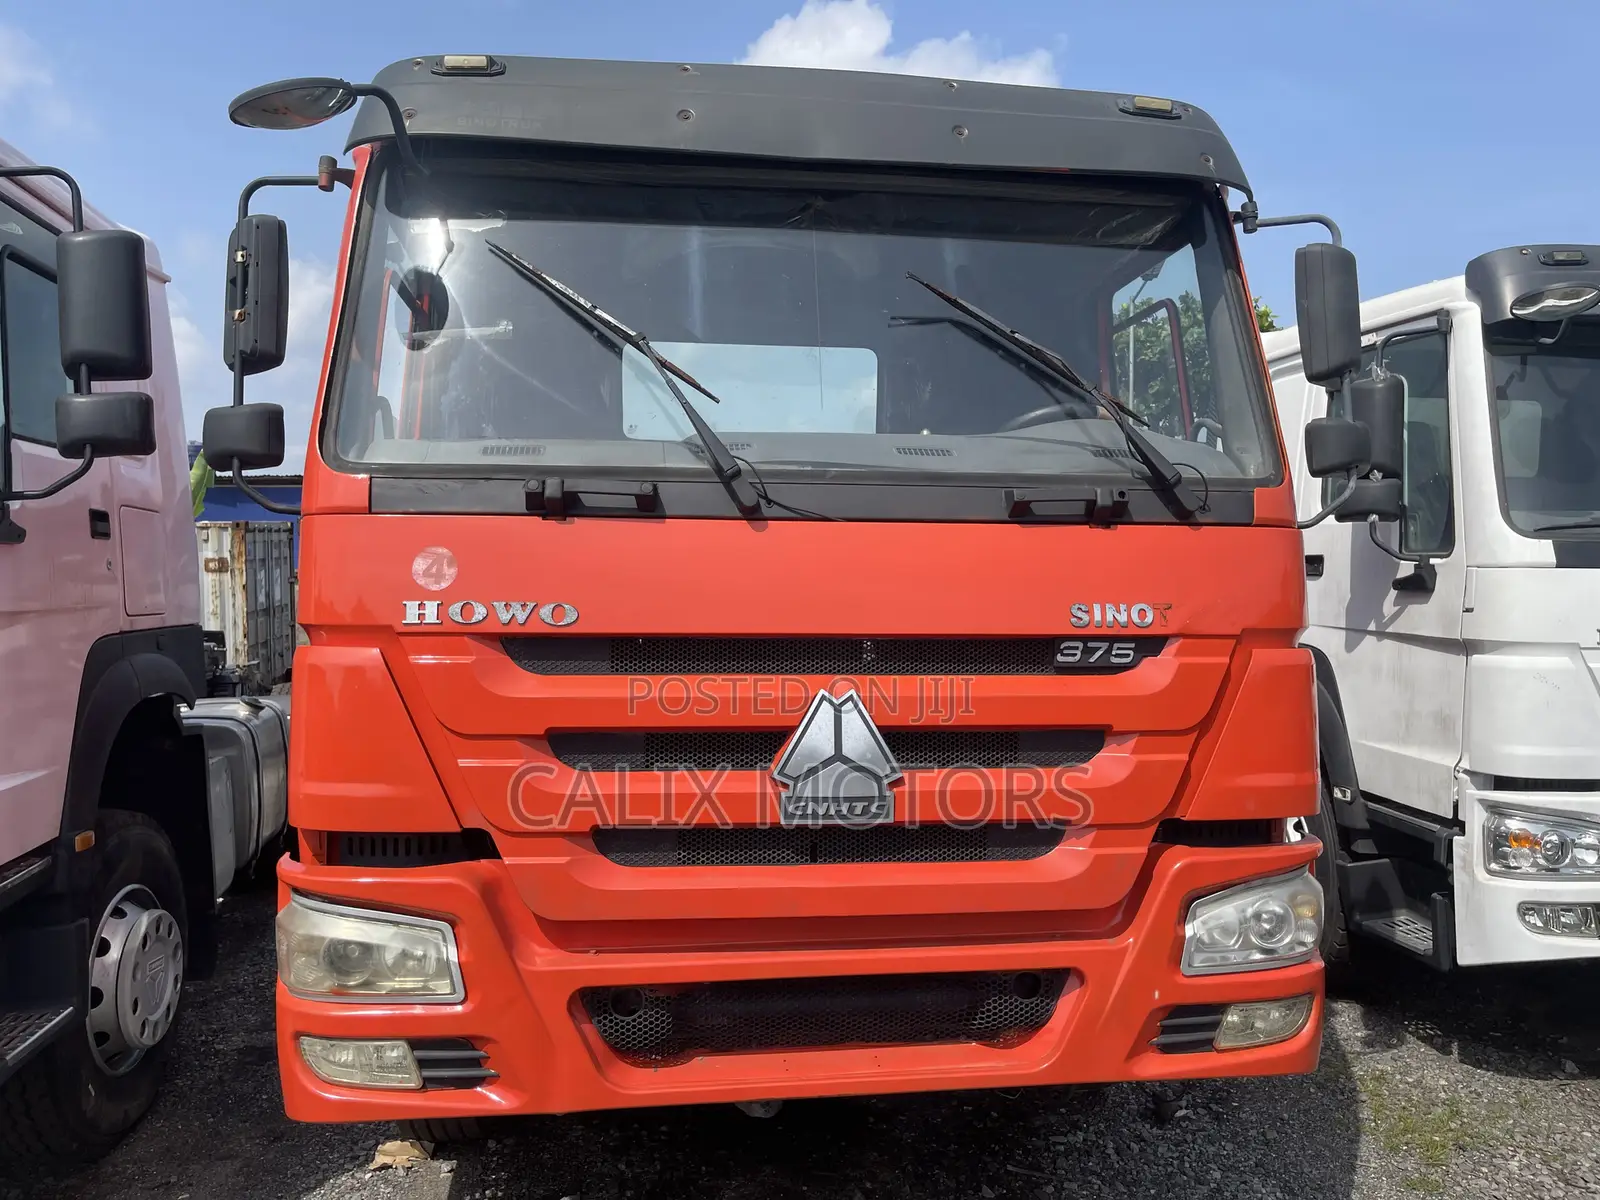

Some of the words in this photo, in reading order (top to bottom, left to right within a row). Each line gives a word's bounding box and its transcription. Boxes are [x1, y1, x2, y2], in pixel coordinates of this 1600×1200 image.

[421, 551, 450, 585] 4
[401, 600, 579, 626] HOWO
[1056, 641, 1136, 664] 375
